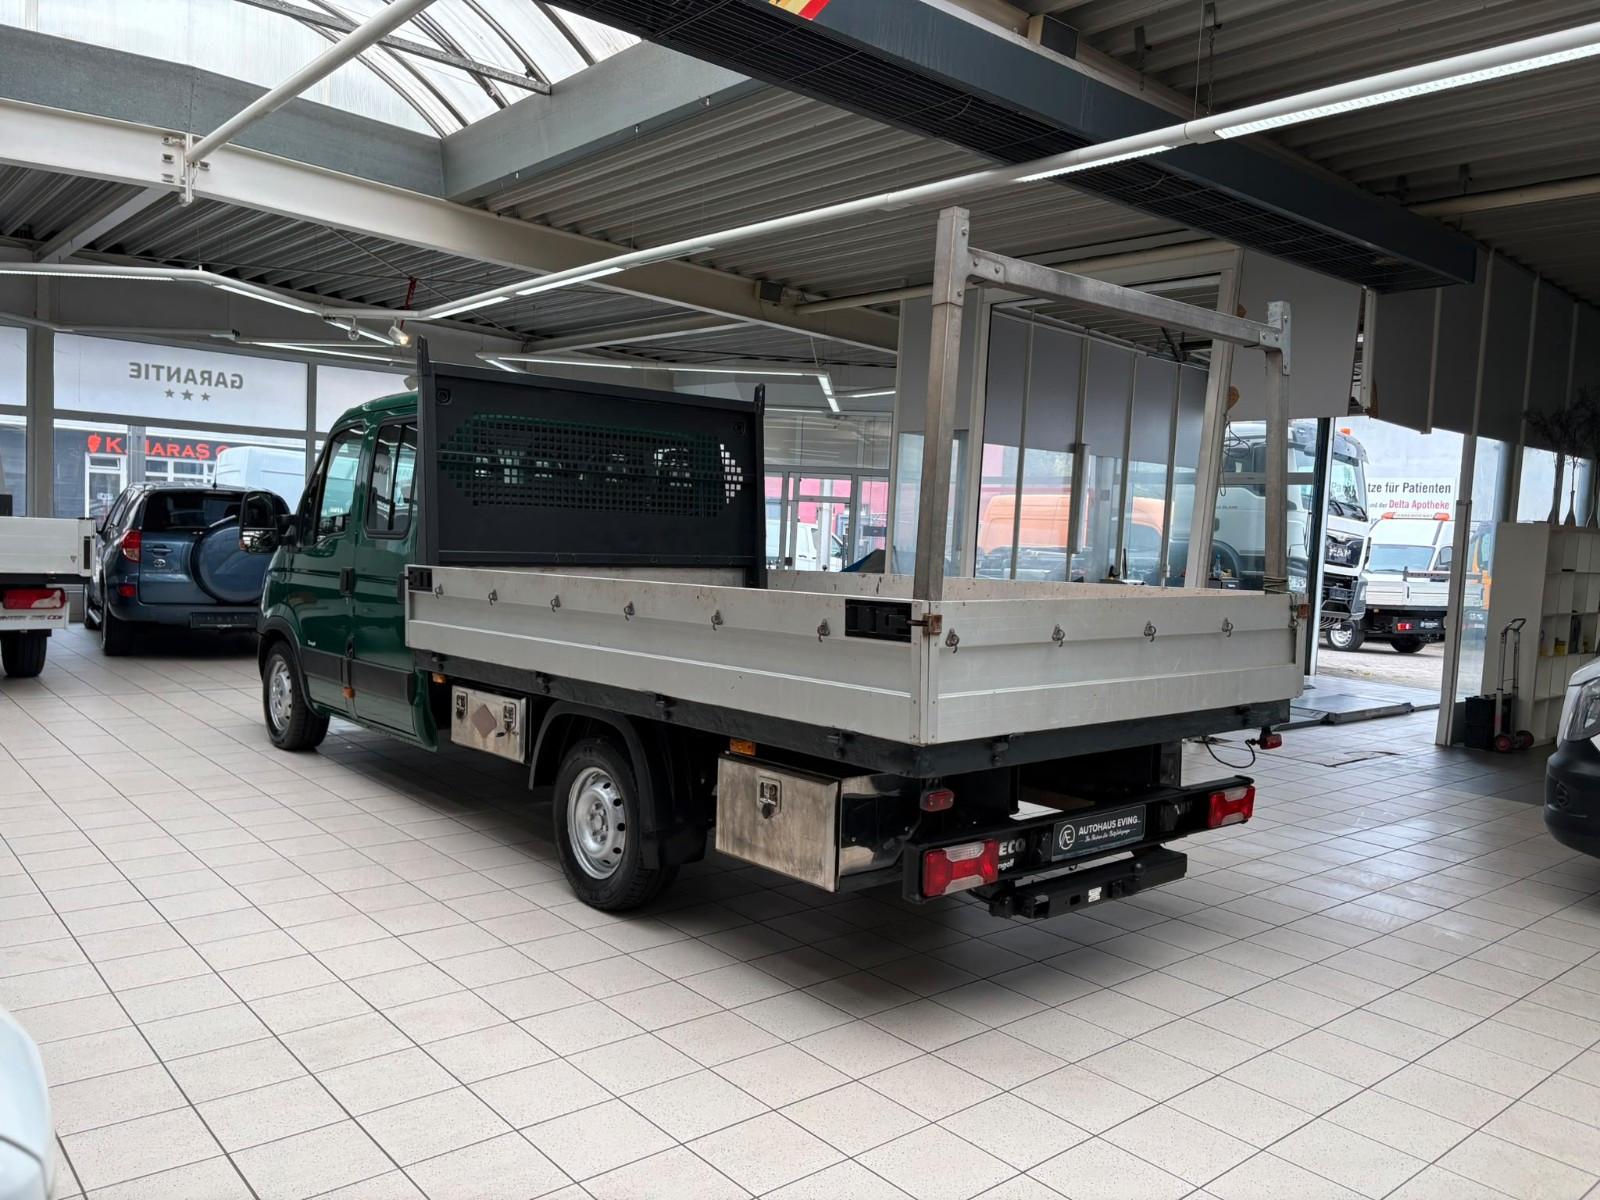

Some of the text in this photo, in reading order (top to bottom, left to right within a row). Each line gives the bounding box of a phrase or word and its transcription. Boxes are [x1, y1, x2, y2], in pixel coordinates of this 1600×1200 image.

[1368, 481, 1451, 494] tze für Patienten
[1389, 499, 1410, 508] Delta
[1411, 500, 1450, 510] Apotheke
[1079, 820, 1117, 836] AUTOHAUS
[998, 838, 1026, 857] ECO
